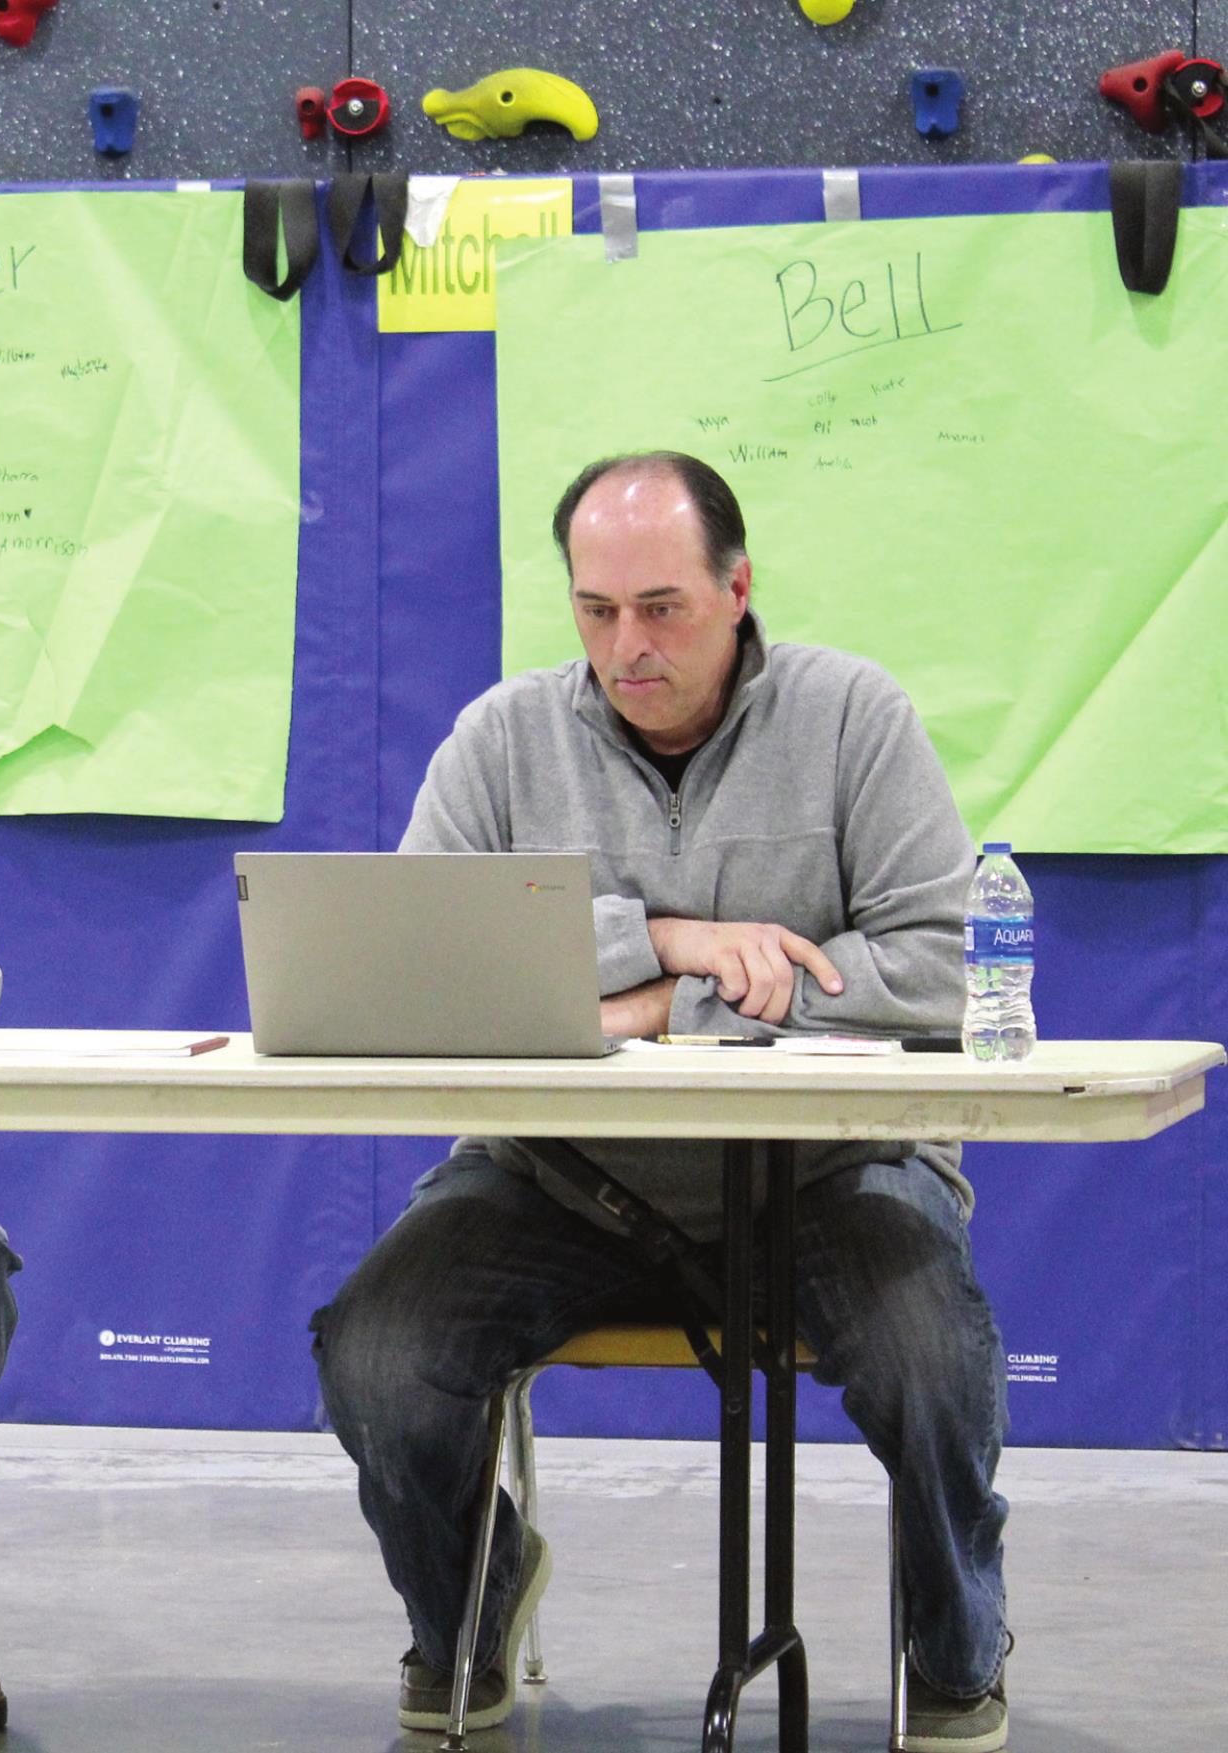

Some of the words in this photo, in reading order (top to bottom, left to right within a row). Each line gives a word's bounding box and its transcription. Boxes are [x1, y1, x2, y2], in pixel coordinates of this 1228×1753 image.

[775, 251, 932, 352] Bell
[116, 1333, 162, 1345] EVERLAST
[163, 1336, 210, 1347] CLIMBING
[1007, 1353, 1058, 1365] CLIMBING
